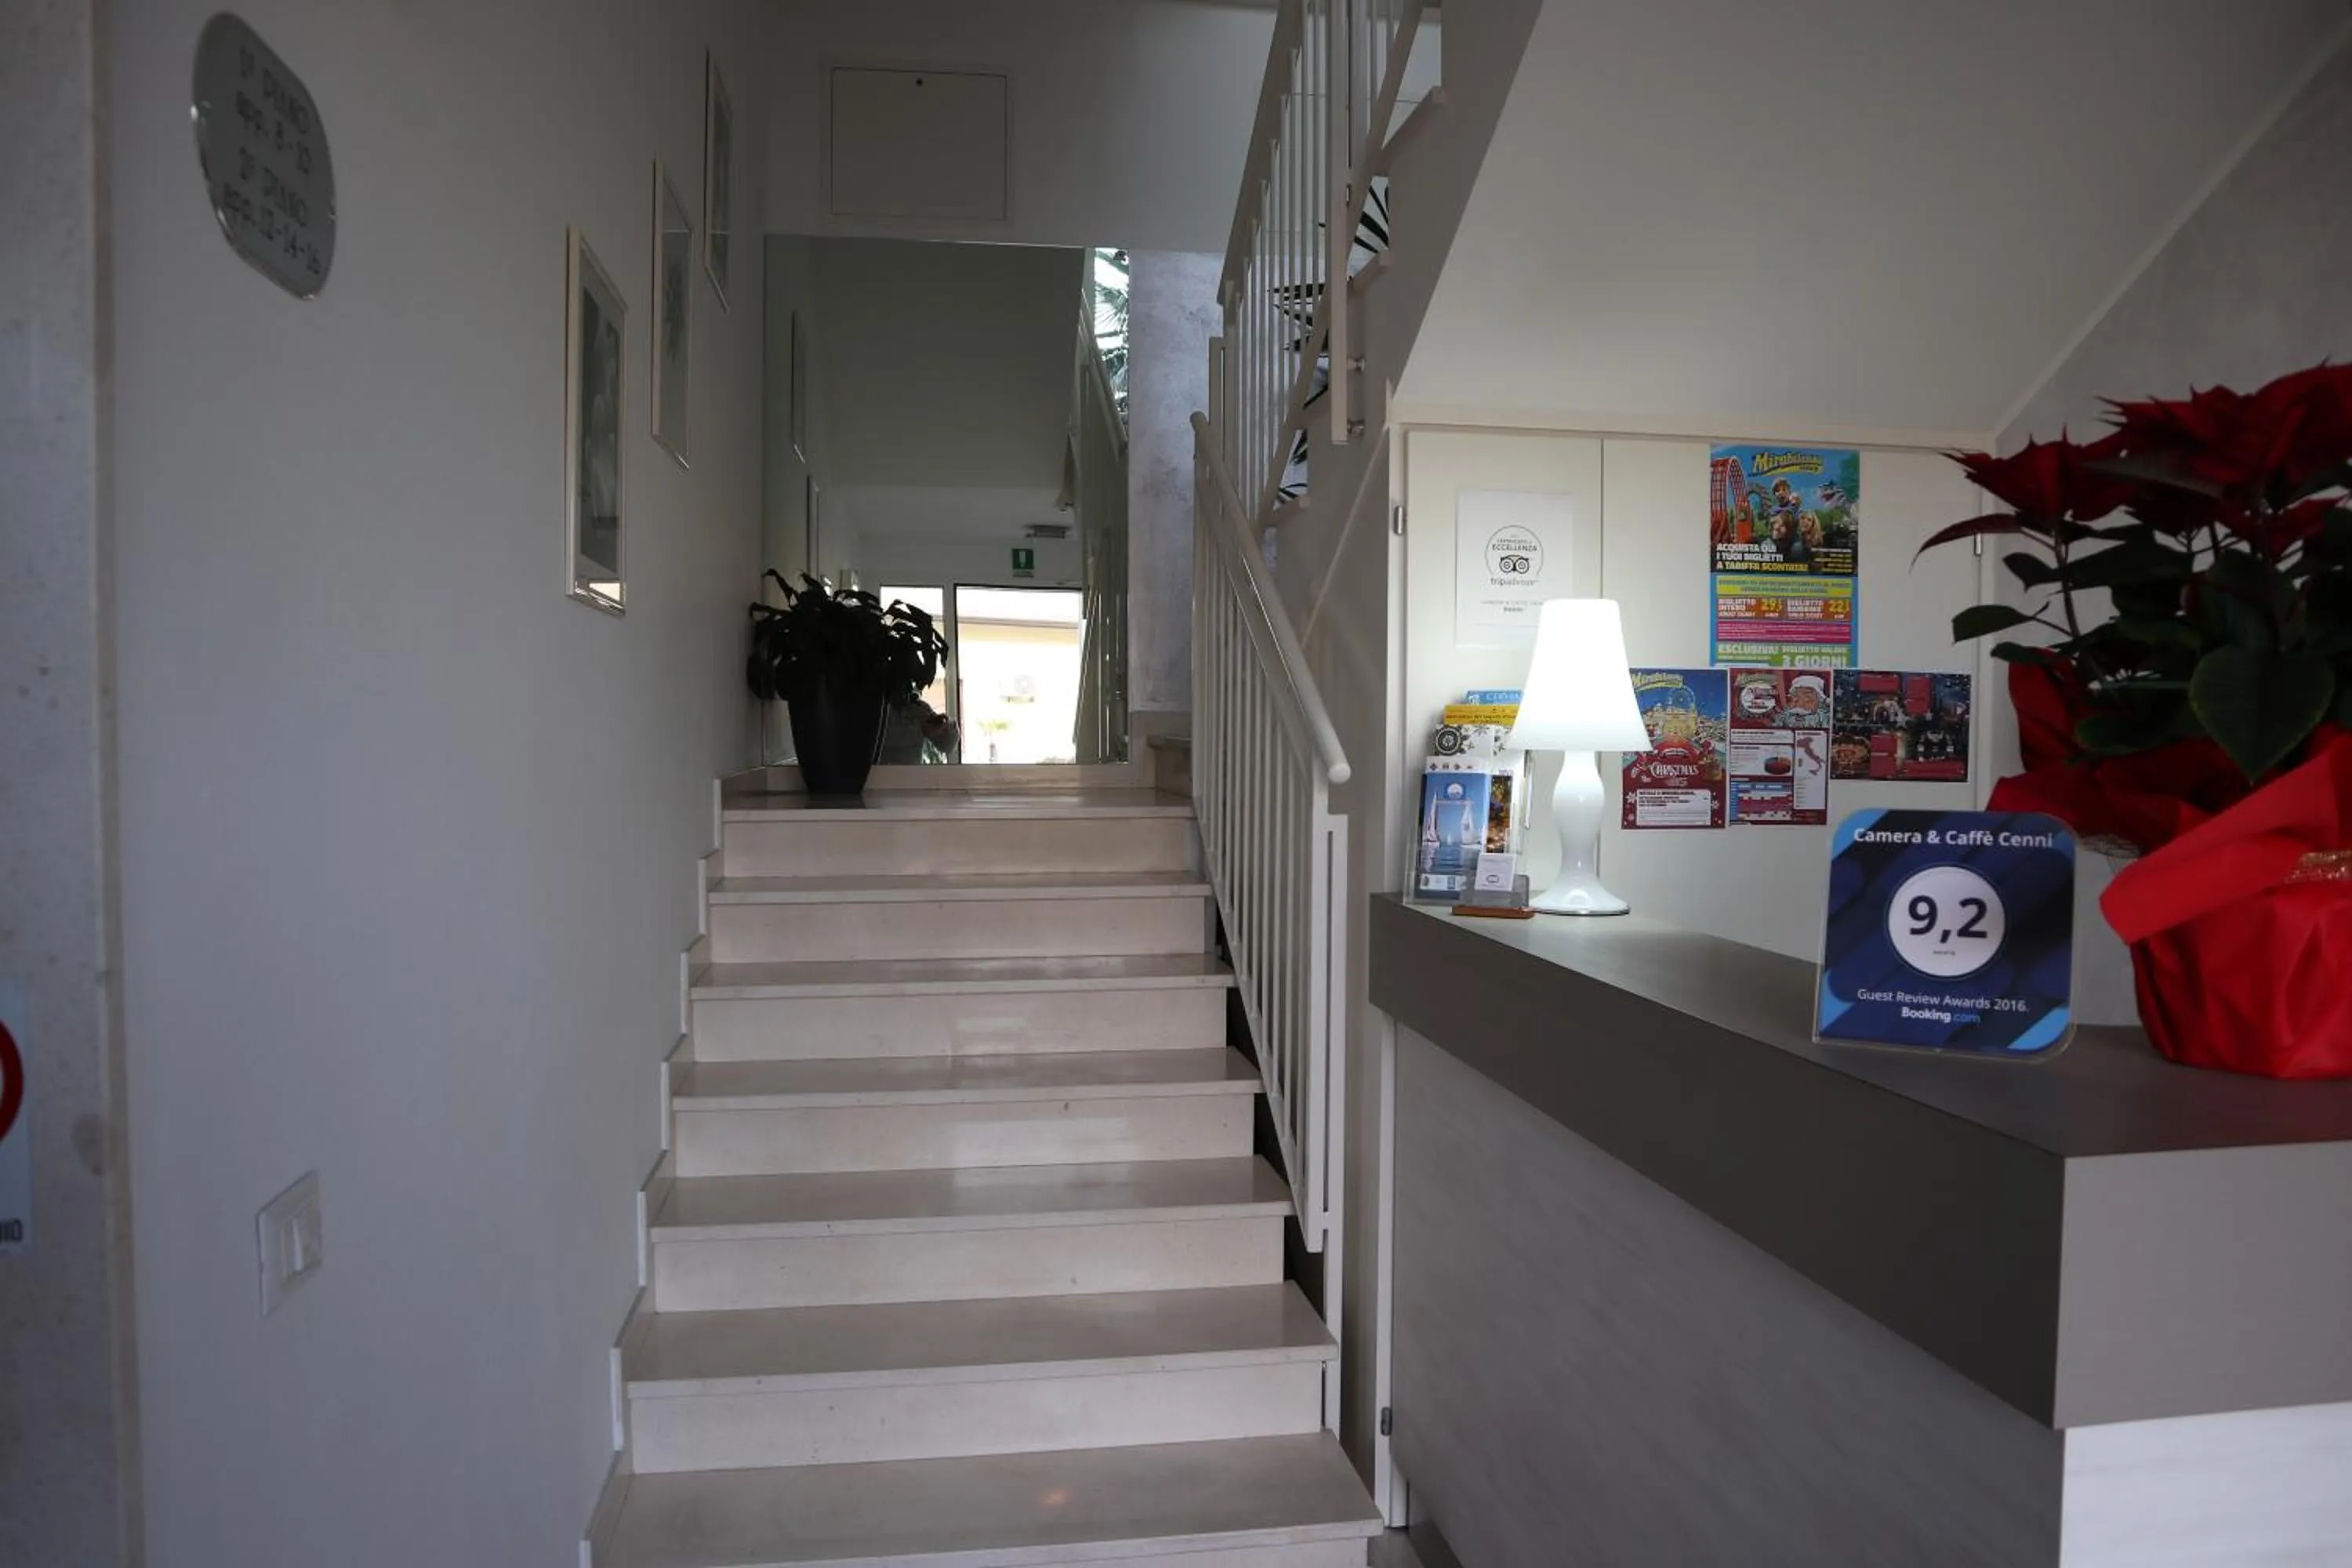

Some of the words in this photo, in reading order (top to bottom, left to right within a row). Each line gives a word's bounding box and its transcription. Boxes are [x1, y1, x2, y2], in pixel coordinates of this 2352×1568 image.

[1716, 543, 1759, 553] ACQUISTA
[1716, 561, 1724, 570] A
[1853, 828, 1922, 845] Camera
[1926, 830, 1941, 845] &
[1999, 831, 2053, 849] Cenni
[1907, 895, 1988, 944] 9,2
[1857, 988, 1893, 1003] Guest
[1896, 991, 1941, 1006] Review
[1943, 995, 1991, 1010] Awards
